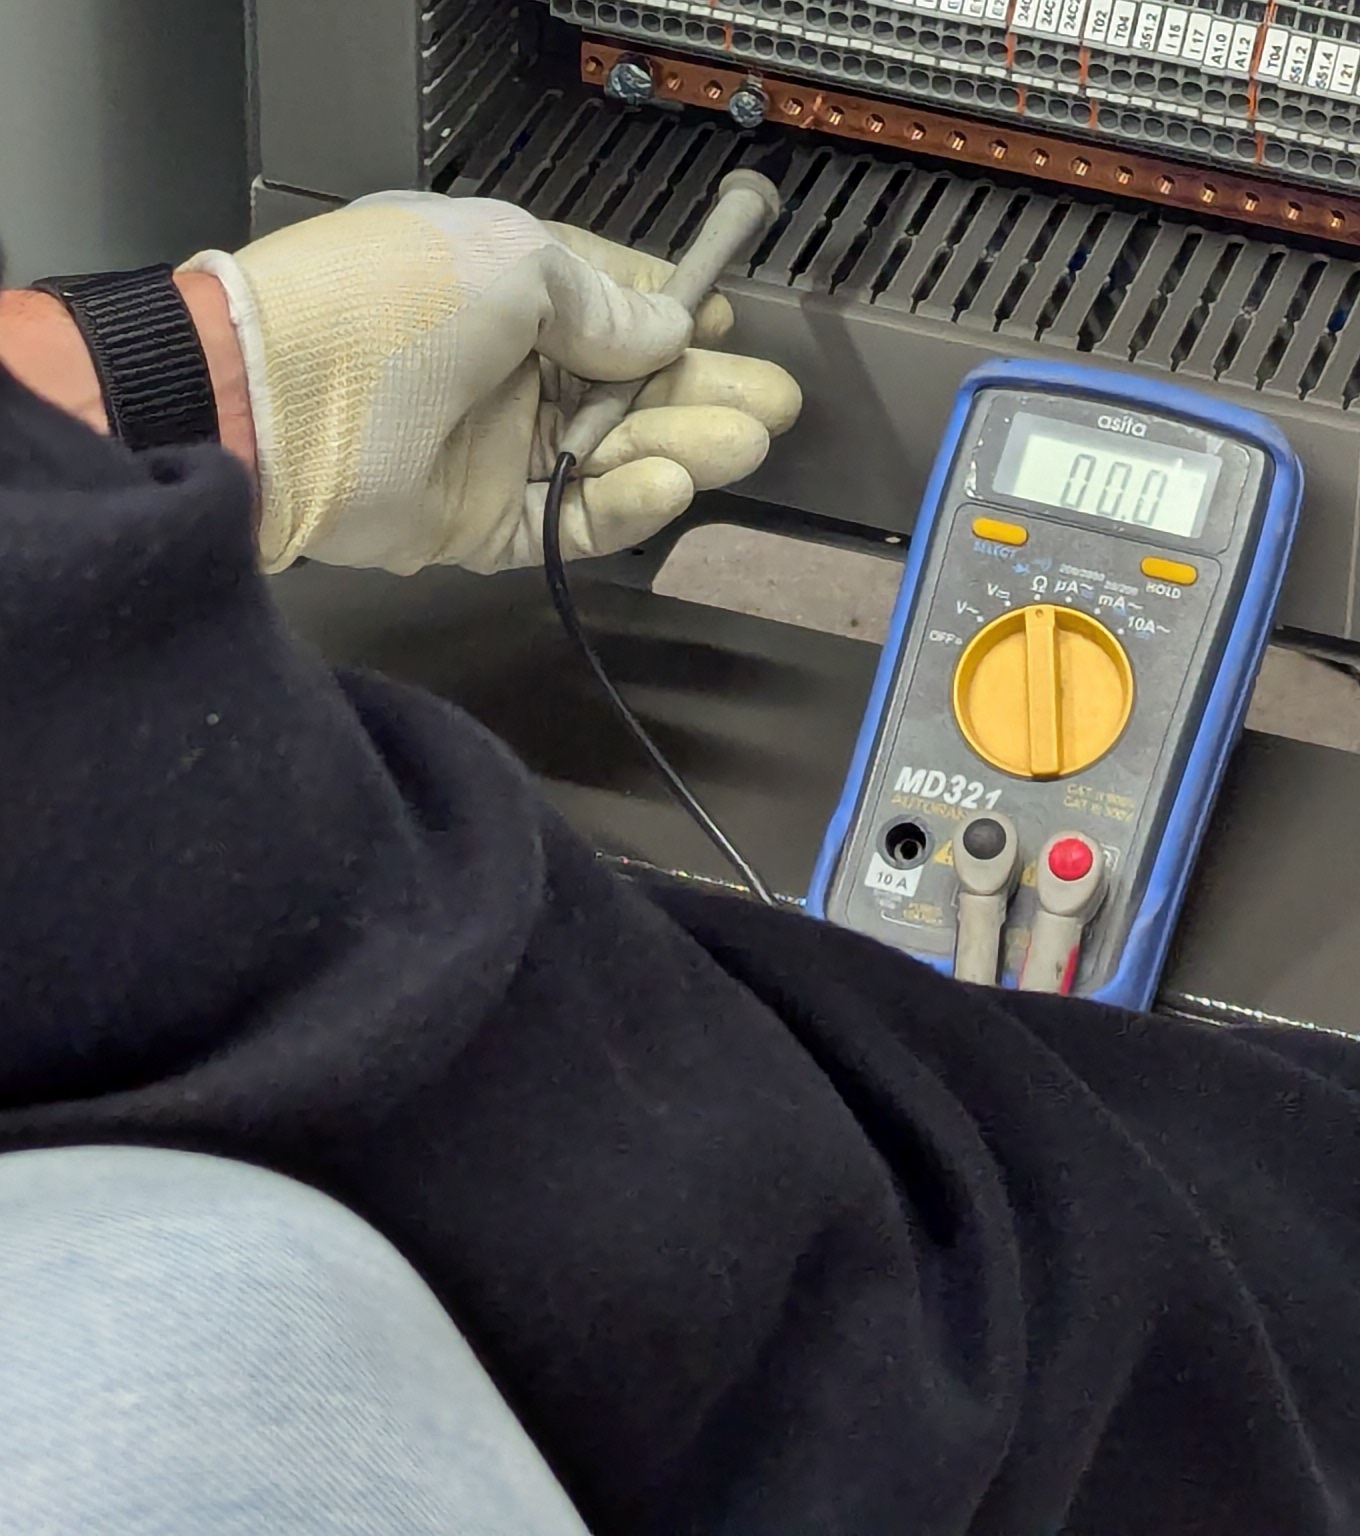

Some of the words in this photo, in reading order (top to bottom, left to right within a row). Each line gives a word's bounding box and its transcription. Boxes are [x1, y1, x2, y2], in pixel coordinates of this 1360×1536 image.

[1092, 10, 1108, 35] T02
[1114, 15, 1129, 40] T04
[1211, 33, 1227, 64] A1.0
[1234, 36, 1251, 67] A1.2
[1267, 45, 1282, 68] T04
[1097, 415, 1147, 437] asita
[1060, 453, 1167, 525] 00.0
[973, 540, 1017, 559] SELECT
[1145, 581, 1181, 599] HOLD
[894, 766, 1002, 809] MD321
[876, 872, 893, 886] 10
[896, 876, 908, 890] A
